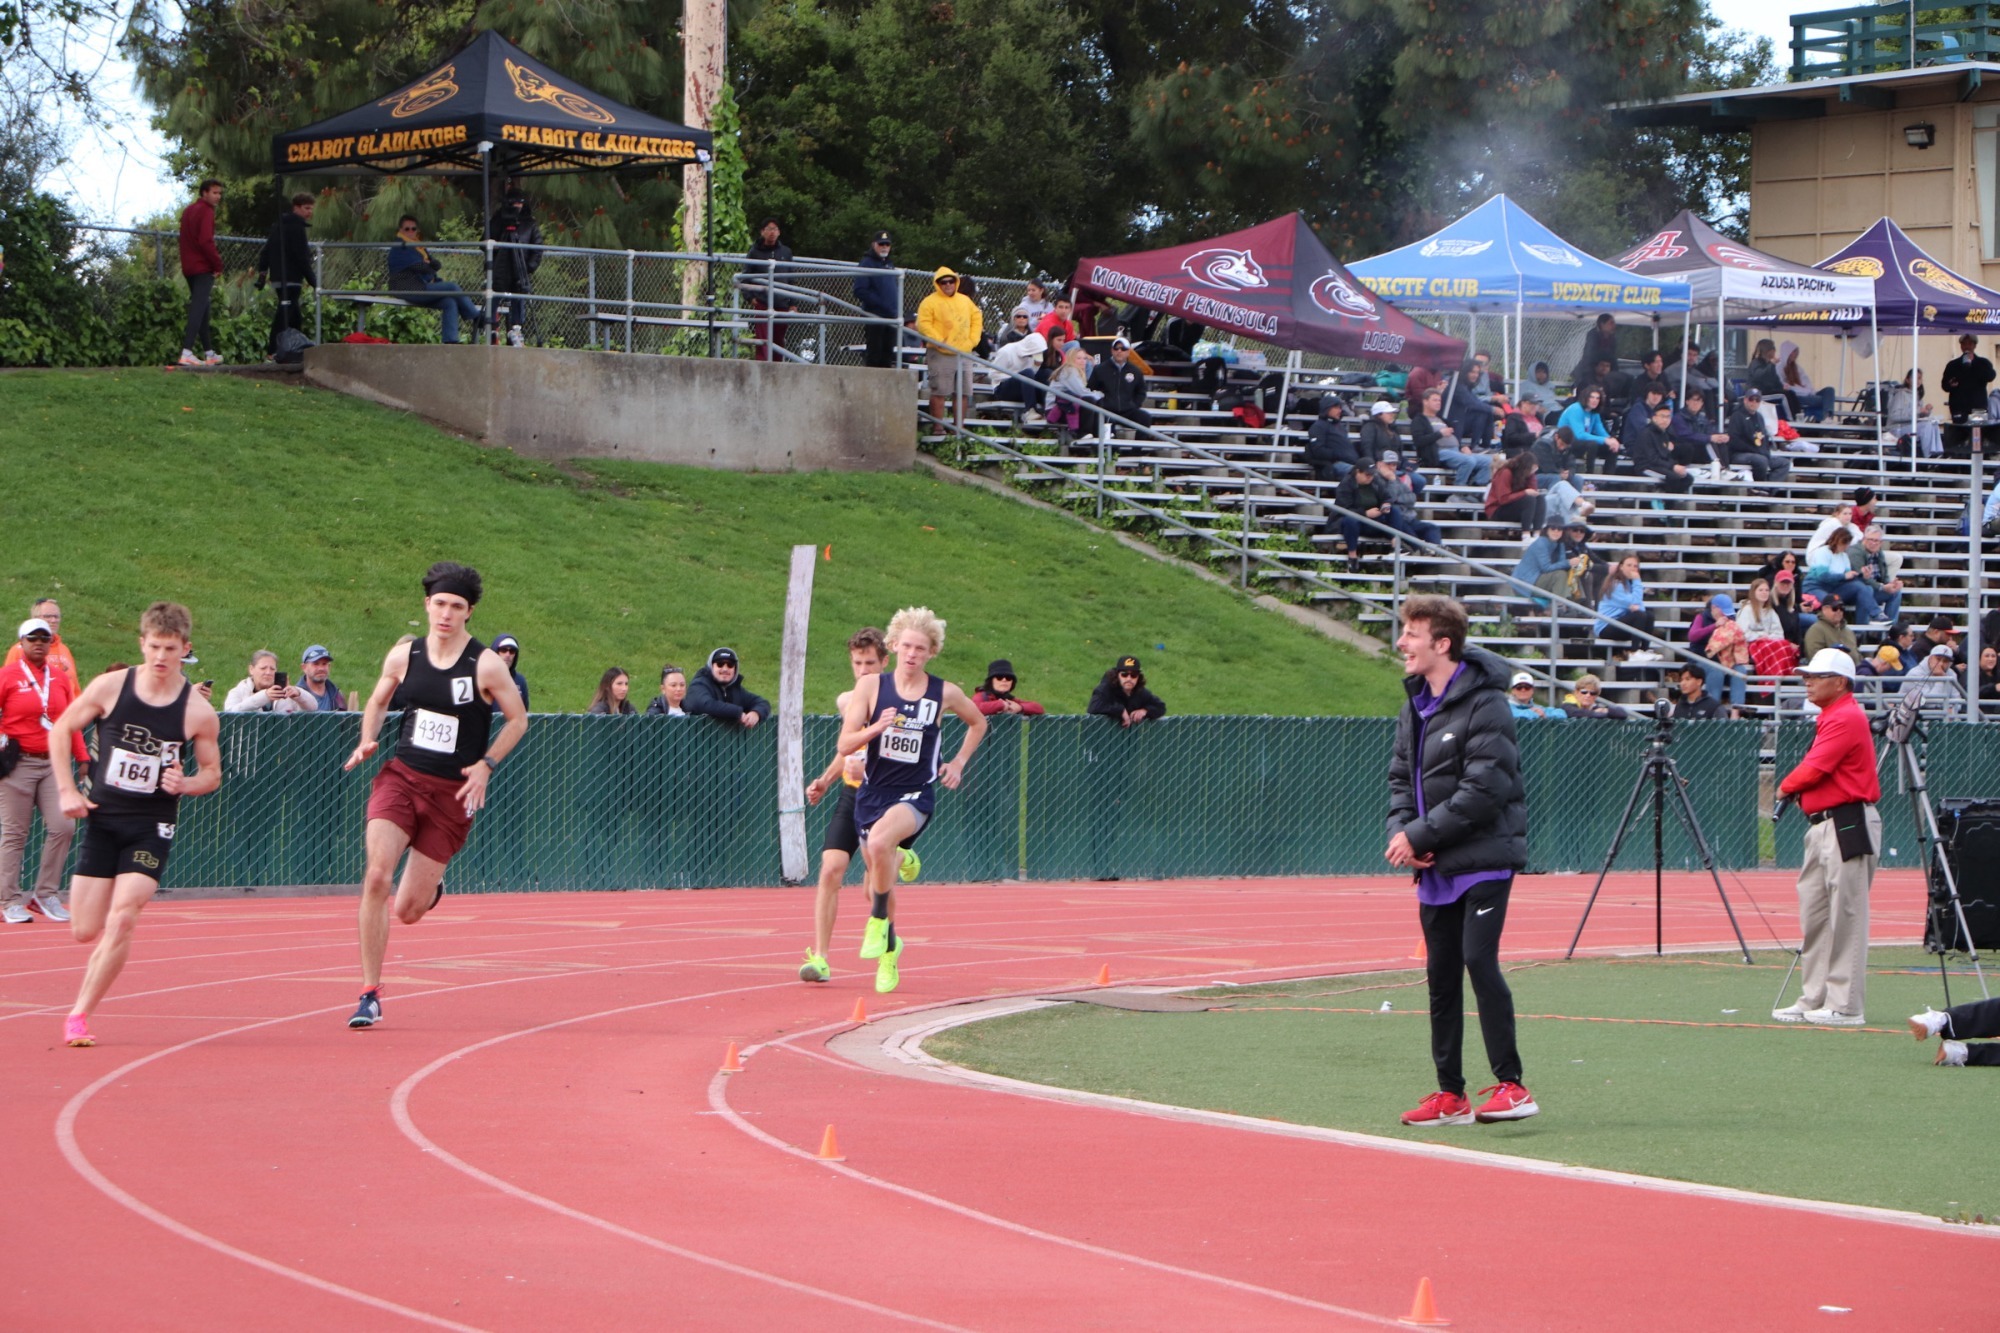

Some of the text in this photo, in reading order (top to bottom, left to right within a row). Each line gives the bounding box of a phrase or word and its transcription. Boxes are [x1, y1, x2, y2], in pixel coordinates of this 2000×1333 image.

[288, 124, 468, 163] CHABOT GLADIATORS
[501, 124, 696, 159] CHABOT GLADIATORS
[1429, 278, 1479, 297] CLUB
[1761, 275, 1836, 292] AZUSA PACIFIC
[1091, 265, 1279, 335] MONTEREY PENINSULA
[1623, 286, 1661, 304] CLUB
[1362, 331, 1406, 354] LOBOS
[457, 679, 470, 702] 2
[925, 702, 932, 721] 1
[122, 724, 165, 757] BC
[418, 720, 452, 743] 4343
[166, 743, 178, 764] 3
[884, 735, 919, 754] 1860
[119, 761, 151, 782] 164
